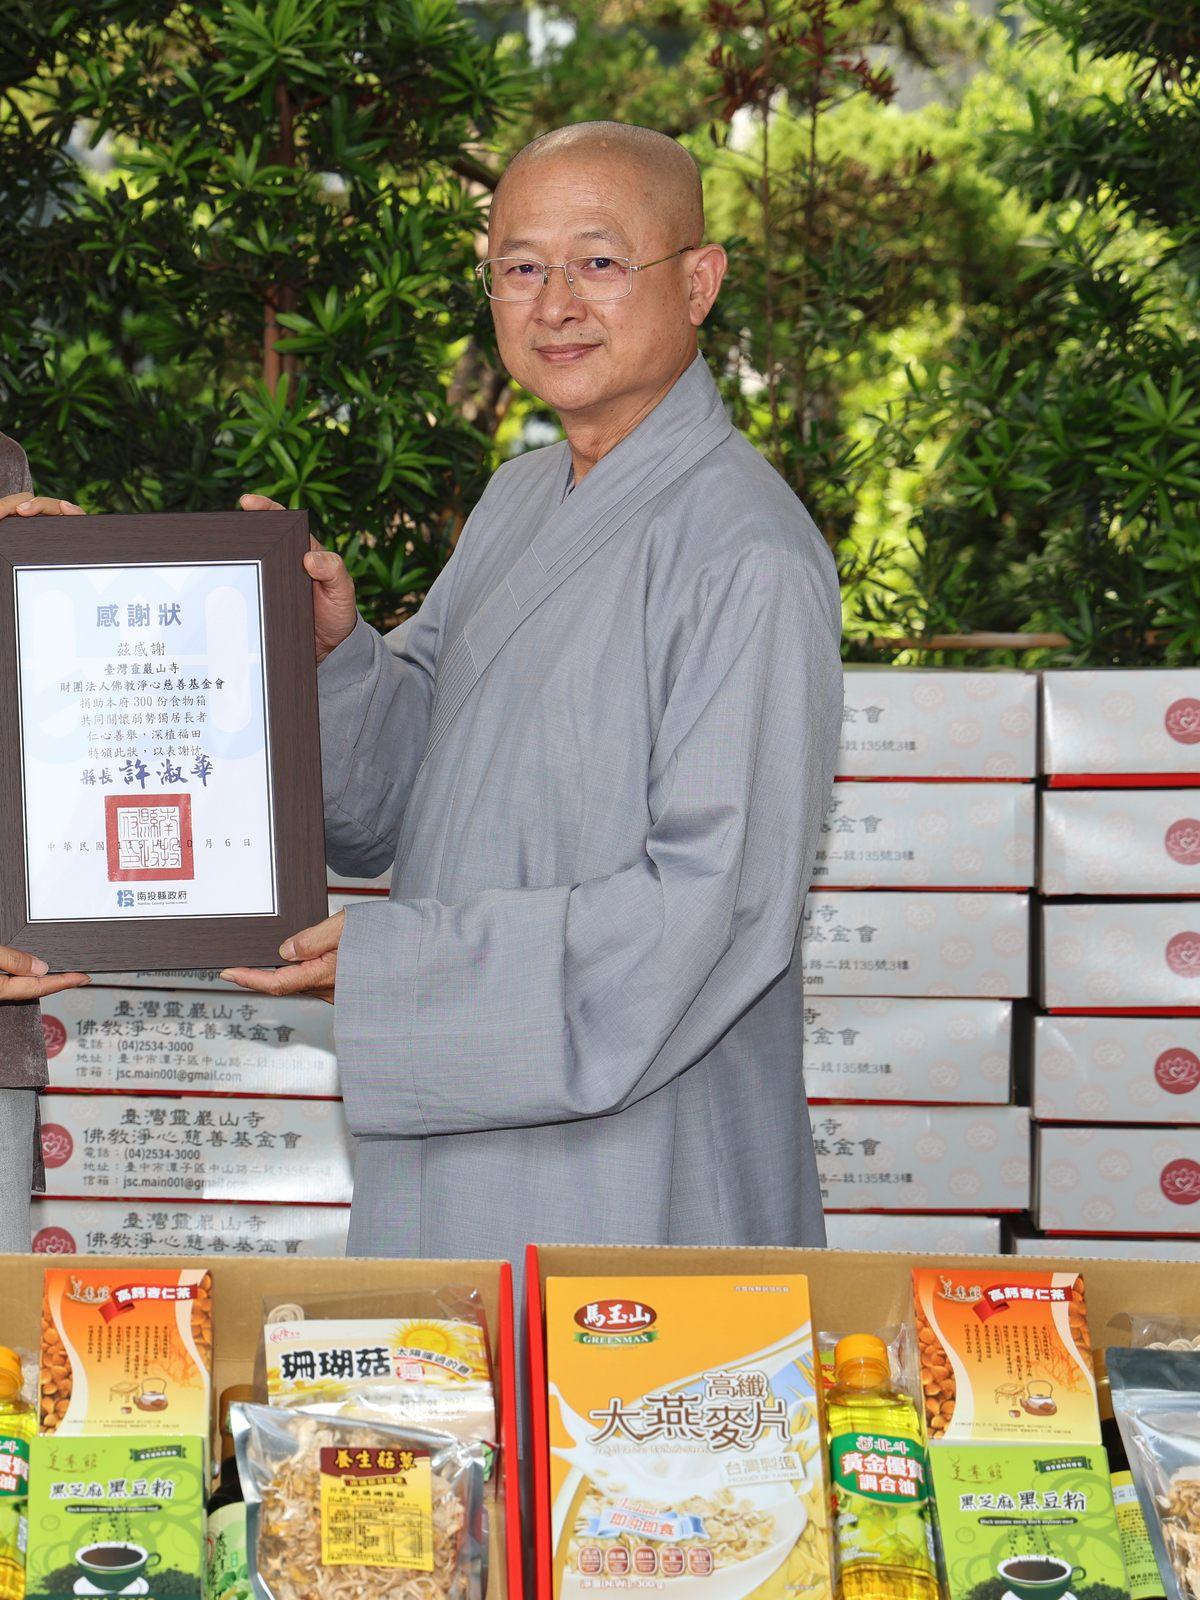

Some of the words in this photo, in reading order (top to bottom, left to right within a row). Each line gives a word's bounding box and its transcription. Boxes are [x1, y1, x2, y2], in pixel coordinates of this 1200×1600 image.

[97, 602, 182, 628] 感謝狀
[117, 641, 166, 657] 茲感謝
[104, 662, 180, 675] 臺灣靈巖山寺
[60, 678, 225, 693] 財團法人佛教淨心慈善基金會
[81, 712, 208, 726] 共同關懷弱勢獨居長者
[137, 890, 188, 901] 南投縣政府
[114, 1001, 259, 1021] 臺灣靈巖山寺
[76, 1019, 296, 1042] 佛教淨心慈善基金會
[120, 1109, 265, 1128] 臺灣靈巖山寺
[83, 1128, 302, 1149] 佛教淨心慈善基金會
[123, 1213, 267, 1231] 臺灣靈巖山寺
[86, 1232, 303, 1253] 佛教淨心慈善基金會
[115, 1286, 191, 1303] 高鈣杏仁茶
[988, 1286, 1066, 1302] 高鈣杏仁茶
[584, 1303, 651, 1326] 馬玉山
[583, 1334, 649, 1345] GREENMAX
[281, 1348, 390, 1379] 珊瑚菇
[705, 1373, 767, 1400] 高纖
[589, 1393, 791, 1452] 大燕麥片
[842, 1452, 924, 1483] 黃金優質
[858, 1474, 917, 1496] 調合油
[960, 1490, 1087, 1512] 黑芝麻黑豆粉
